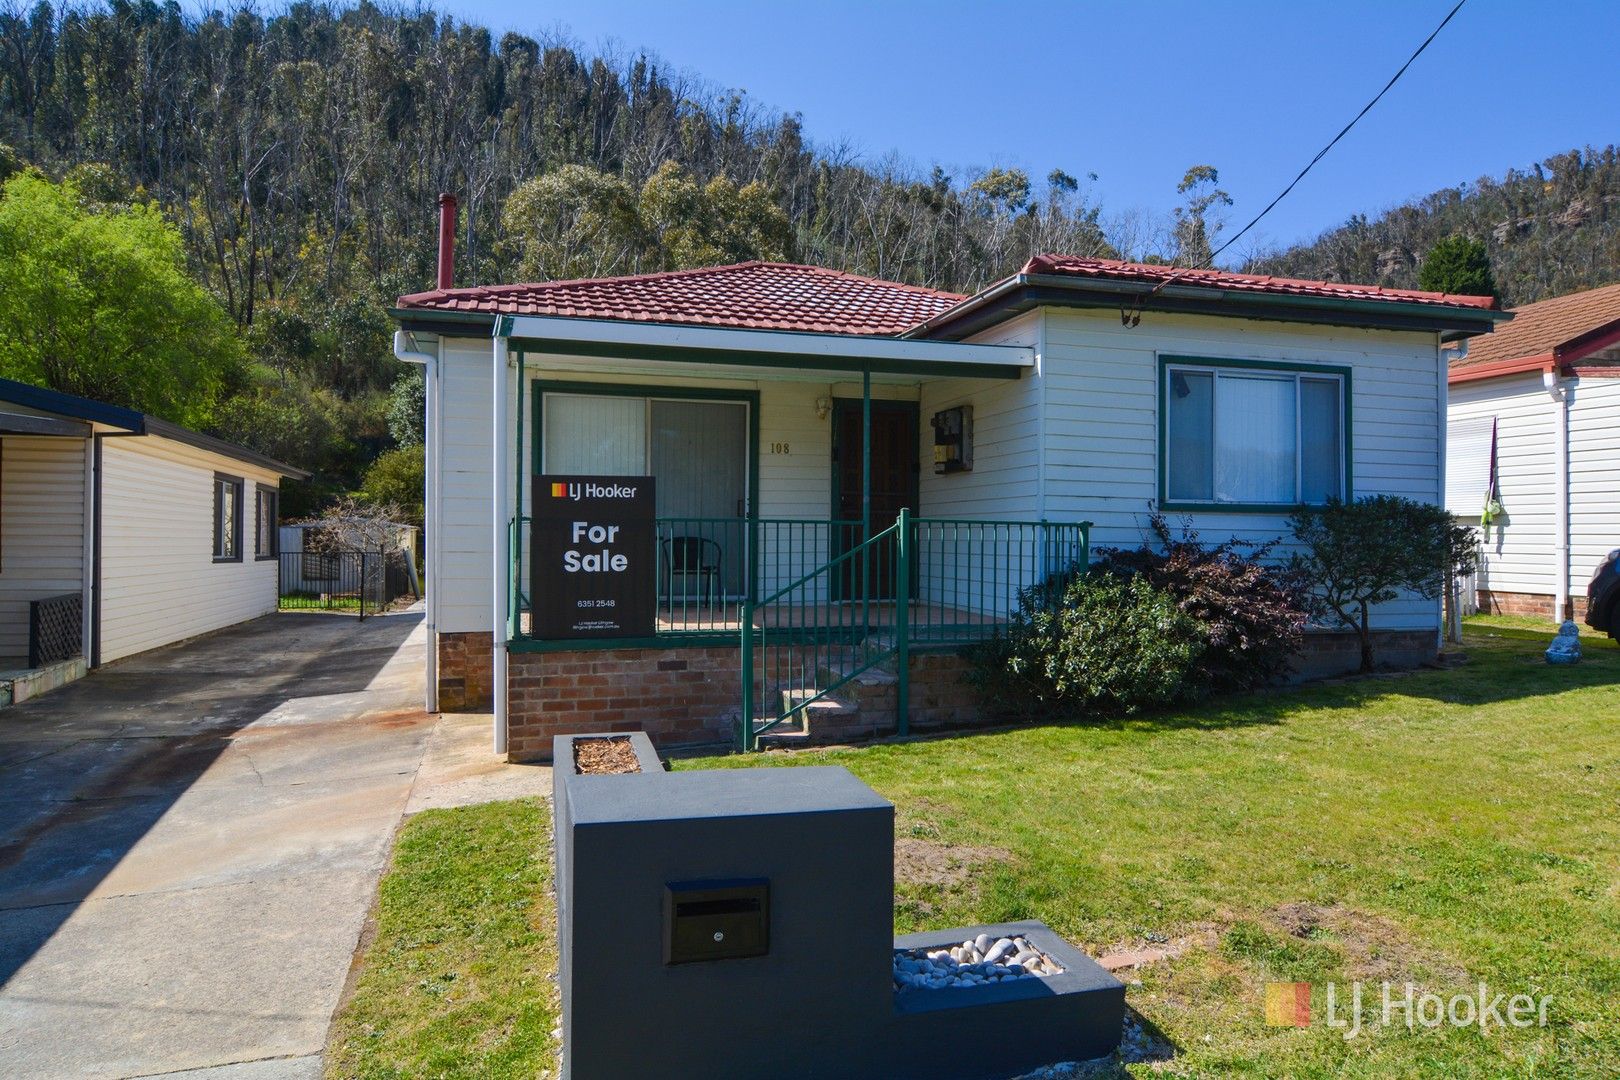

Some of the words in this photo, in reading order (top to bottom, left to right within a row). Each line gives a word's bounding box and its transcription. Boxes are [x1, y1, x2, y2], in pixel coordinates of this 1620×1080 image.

[771, 442, 790, 454] 108
[569, 483, 581, 501] LJ
[585, 483, 637, 498] Hooker
[572, 521, 620, 544] For
[564, 549, 628, 573] Sale
[577, 600, 595, 608] 6351
